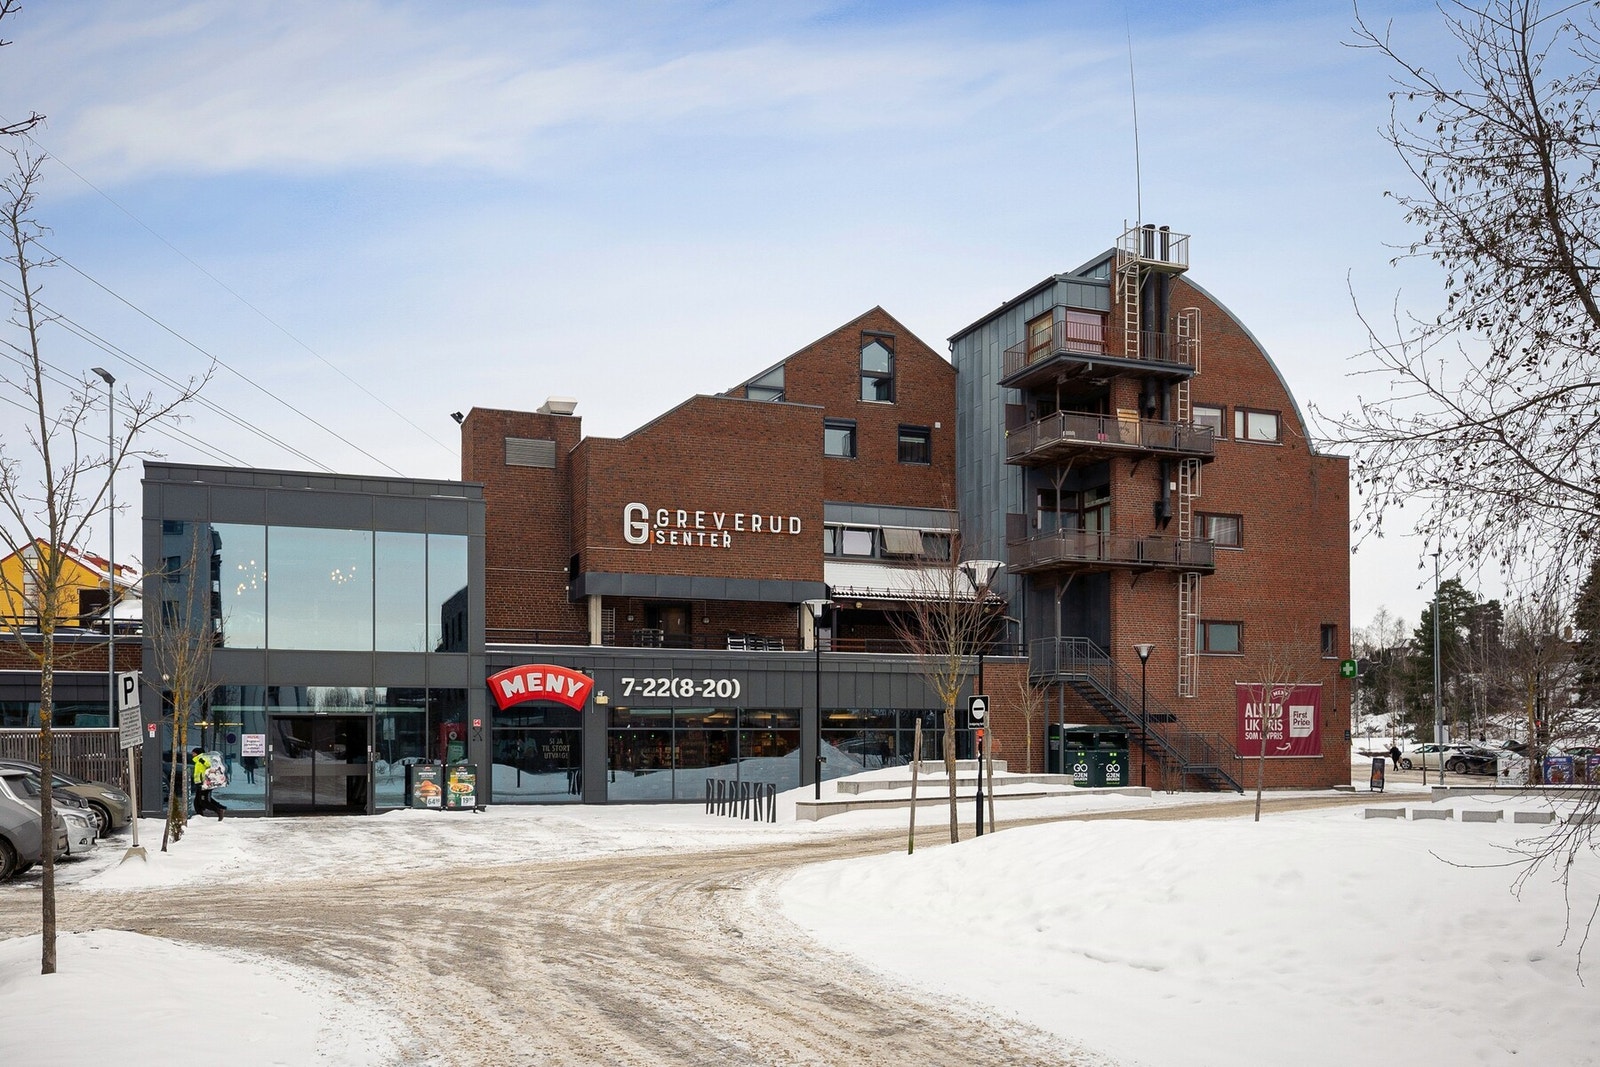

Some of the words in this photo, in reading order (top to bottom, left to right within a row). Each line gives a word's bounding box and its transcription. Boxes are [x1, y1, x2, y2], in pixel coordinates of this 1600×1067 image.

[656, 508, 802, 535] GREVERUD
[656, 530, 732, 549] SENTER
[123, 676, 135, 706] P
[500, 672, 584, 698] MENY
[621, 677, 741, 699] 7-22(8-20)
[1245, 702, 1283, 718] ALLTID
[1293, 710, 1308, 719] First
[1245, 719, 1260, 731] LIK
[1266, 719, 1283, 731] RIS
[1293, 718, 1310, 726] Price
[1245, 731, 1259, 740] SOM
[1260, 731, 1283, 740] LVPRIS
[552, 744, 570, 752] STORT
[1073, 763, 1088, 773] GO
[1105, 763, 1120, 773] GO
